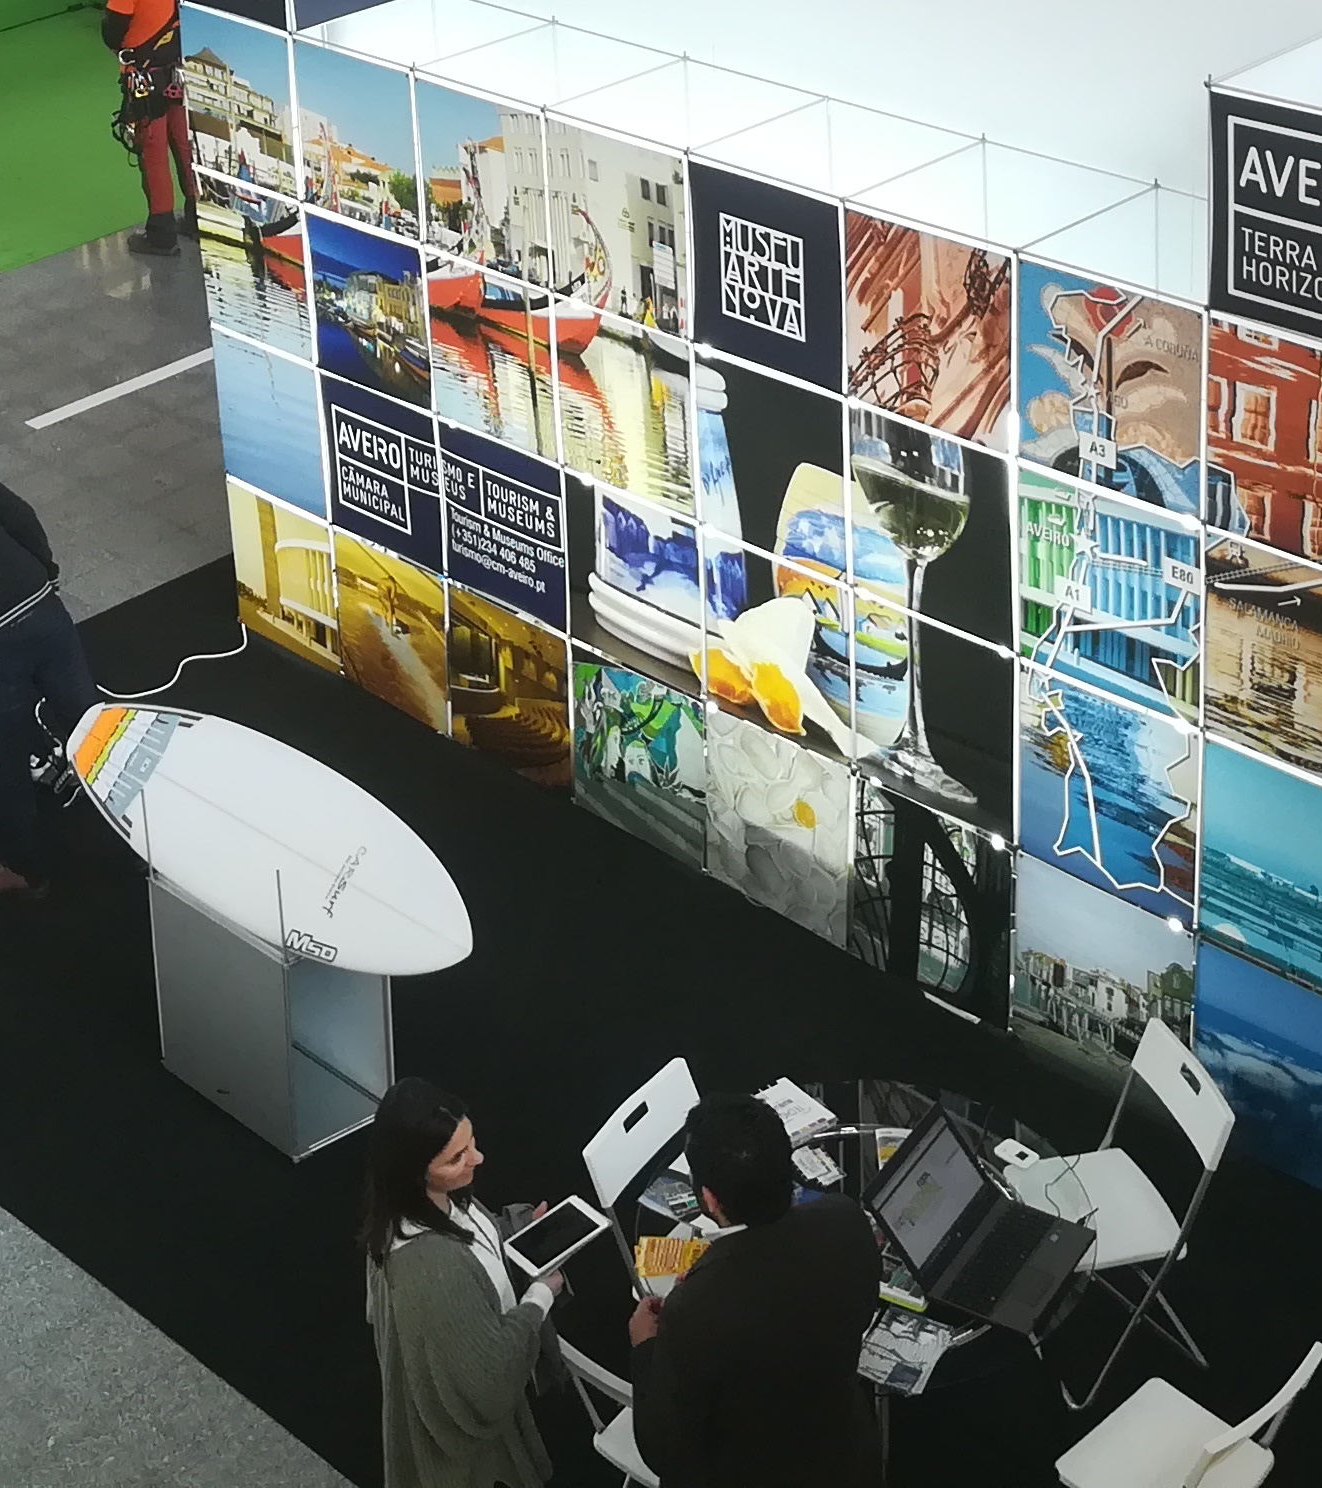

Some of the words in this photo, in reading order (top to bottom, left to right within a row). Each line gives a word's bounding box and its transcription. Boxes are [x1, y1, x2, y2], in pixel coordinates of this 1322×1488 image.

[722, 213, 803, 271] MUSEU
[1241, 226, 1318, 272] TERRA
[724, 250, 803, 307] ARTE
[723, 282, 804, 342] NOVA
[338, 421, 402, 469] AVEIRO
[1088, 440, 1107, 458] A3
[341, 465, 390, 500] CÂMARA
[408, 446, 464, 483] TURISMO
[467, 472, 476, 489] E
[410, 463, 467, 501] MUSEUS
[342, 482, 406, 523] MUNICIPAL
[485, 480, 541, 516] TOURISM
[544, 505, 556, 523] &
[487, 499, 556, 539] MUSEUMS
[450, 507, 482, 533] Tourism
[482, 521, 491, 535] &
[492, 526, 535, 557] Museums
[536, 546, 566, 569] Office
[1026, 524, 1071, 548] AVEIRO
[451, 538, 547, 594] turismo@cm-aveiro.pt
[499, 547, 517, 565] 406
[518, 555, 537, 574] 485
[1171, 566, 1194, 585] E80
[1065, 584, 1081, 600] A1
[1228, 597, 1300, 633] SALAMANCA
[284, 928, 338, 963] MSD
